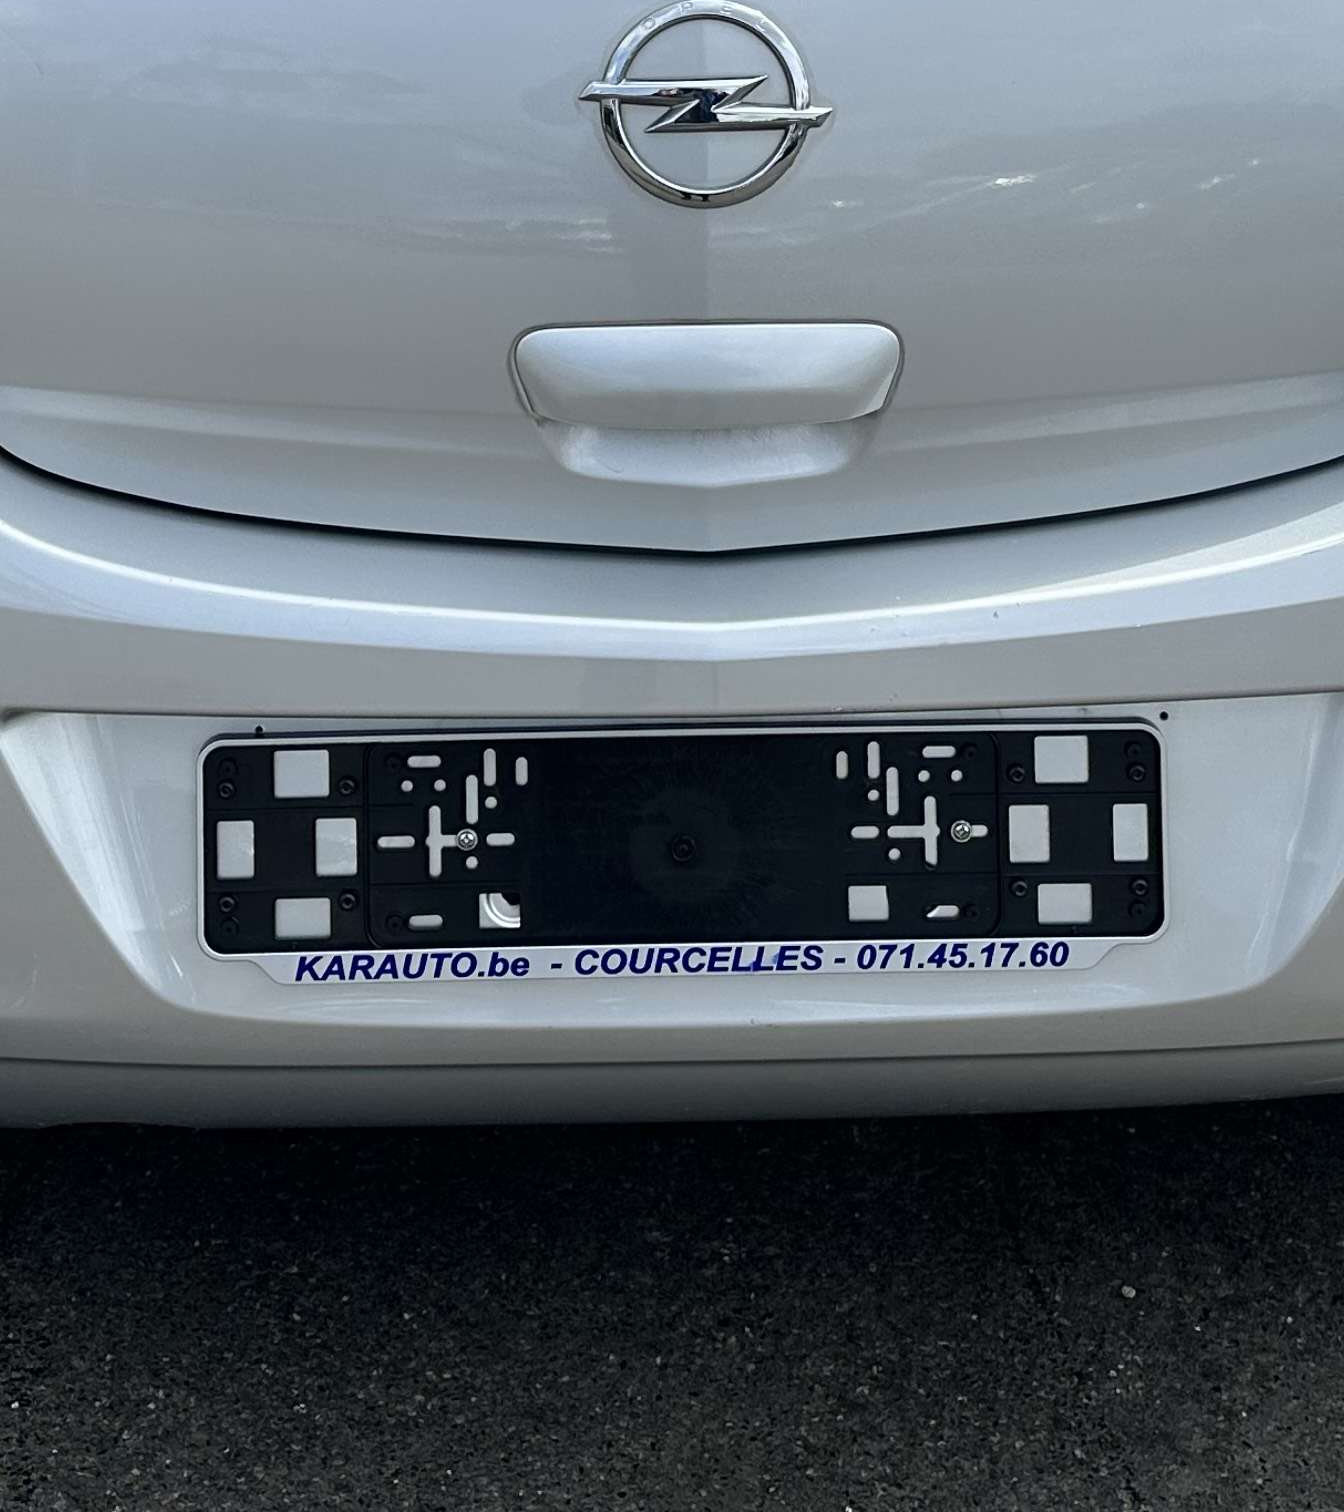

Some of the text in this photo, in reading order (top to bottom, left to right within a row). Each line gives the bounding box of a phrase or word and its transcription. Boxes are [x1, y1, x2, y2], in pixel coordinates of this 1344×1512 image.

[295, 952, 530, 982] KARAUTO.be
[575, 945, 824, 975] COURCELLES
[857, 941, 1070, 970] 071.45.17.60
